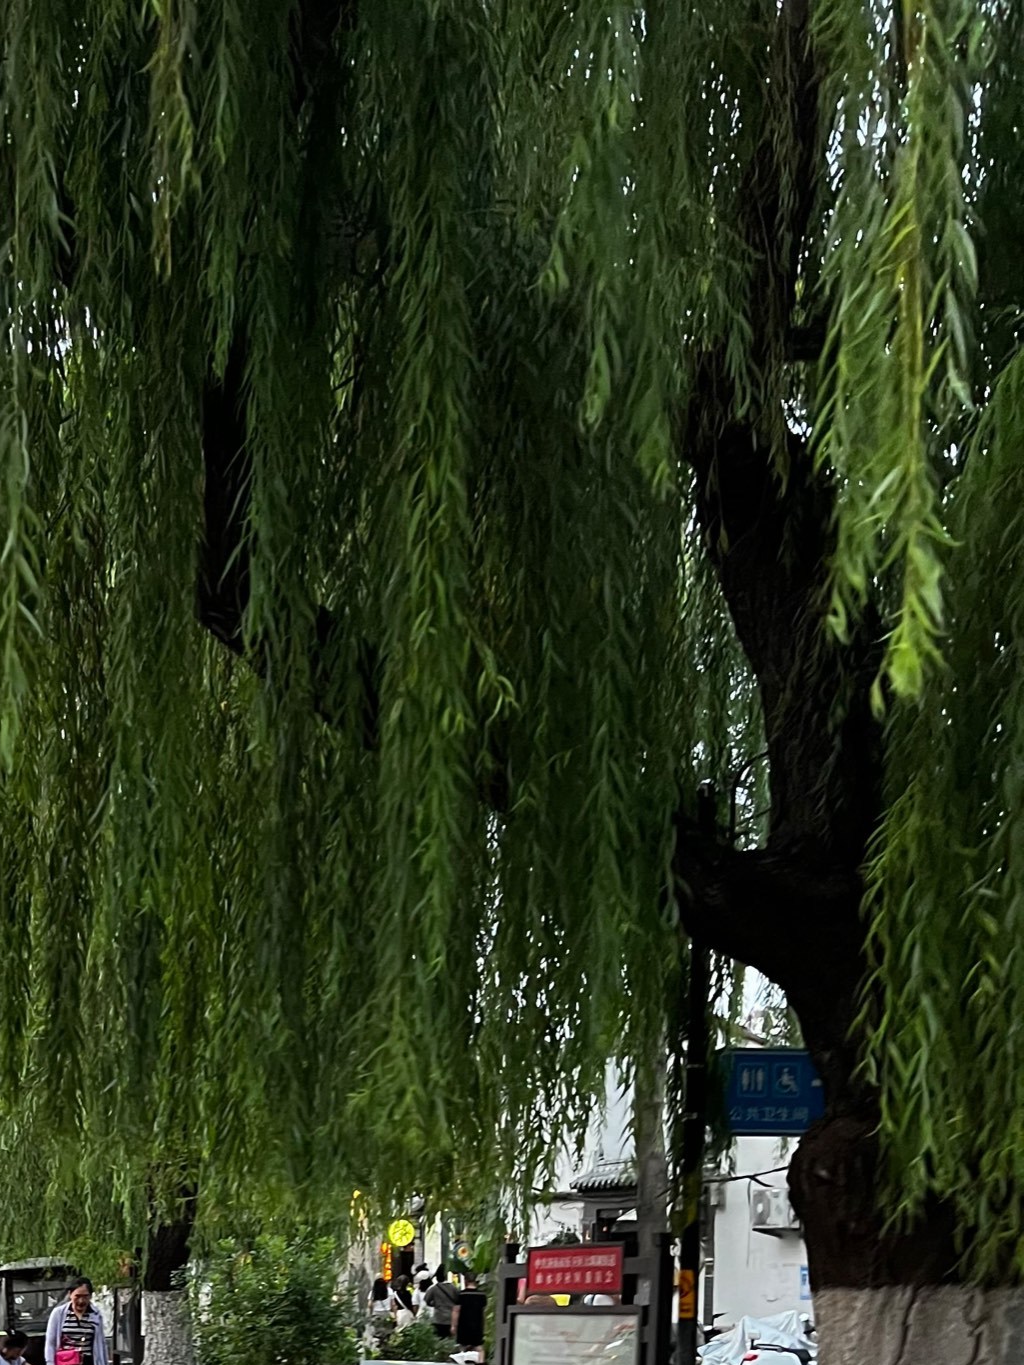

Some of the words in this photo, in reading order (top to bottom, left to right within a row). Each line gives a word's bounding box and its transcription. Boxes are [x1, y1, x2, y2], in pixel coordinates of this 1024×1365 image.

[728, 1105, 810, 1124] 公共卫生间
